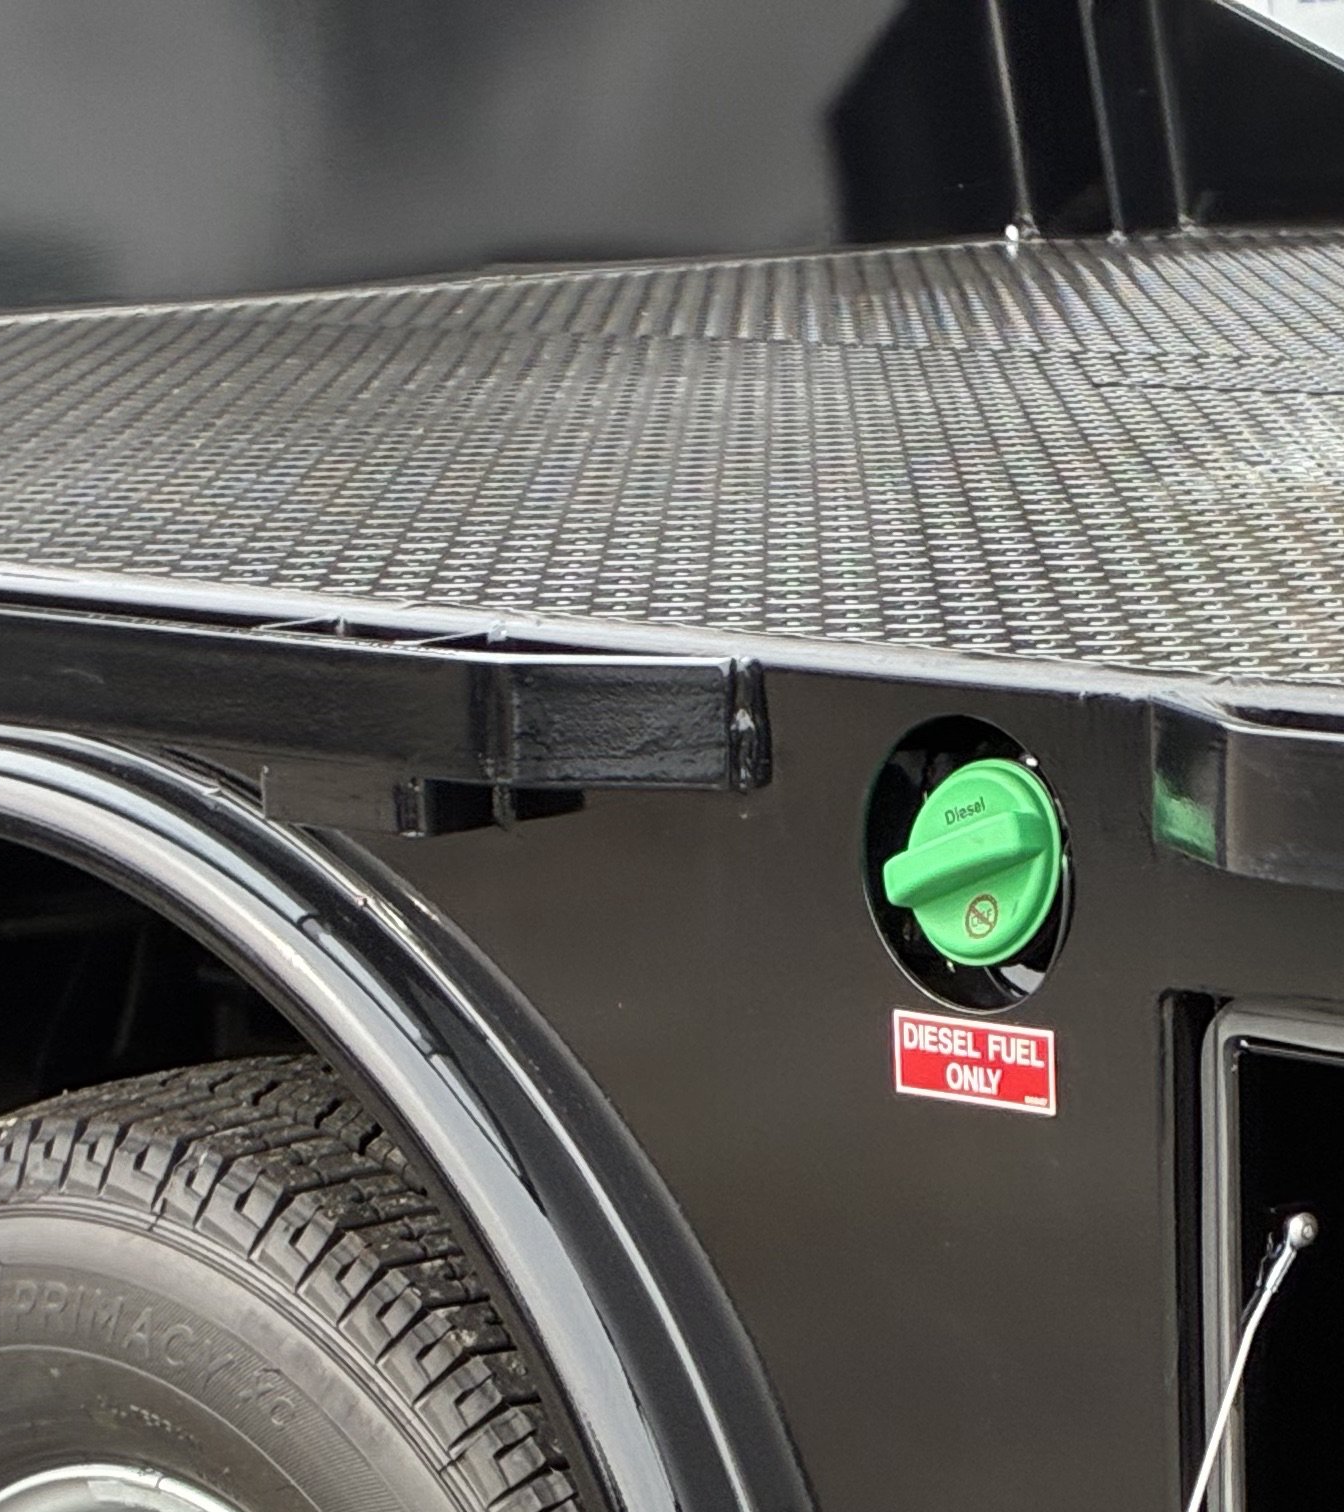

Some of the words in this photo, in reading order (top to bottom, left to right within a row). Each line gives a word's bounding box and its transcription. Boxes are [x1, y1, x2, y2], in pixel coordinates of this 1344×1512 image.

[944, 797, 986, 825] Diesel
[903, 1021, 981, 1059] DIESEL
[987, 1034, 1045, 1068] FUEL
[945, 1062, 1002, 1095] ONLY
[8, 1279, 236, 1395] PRIMACY
